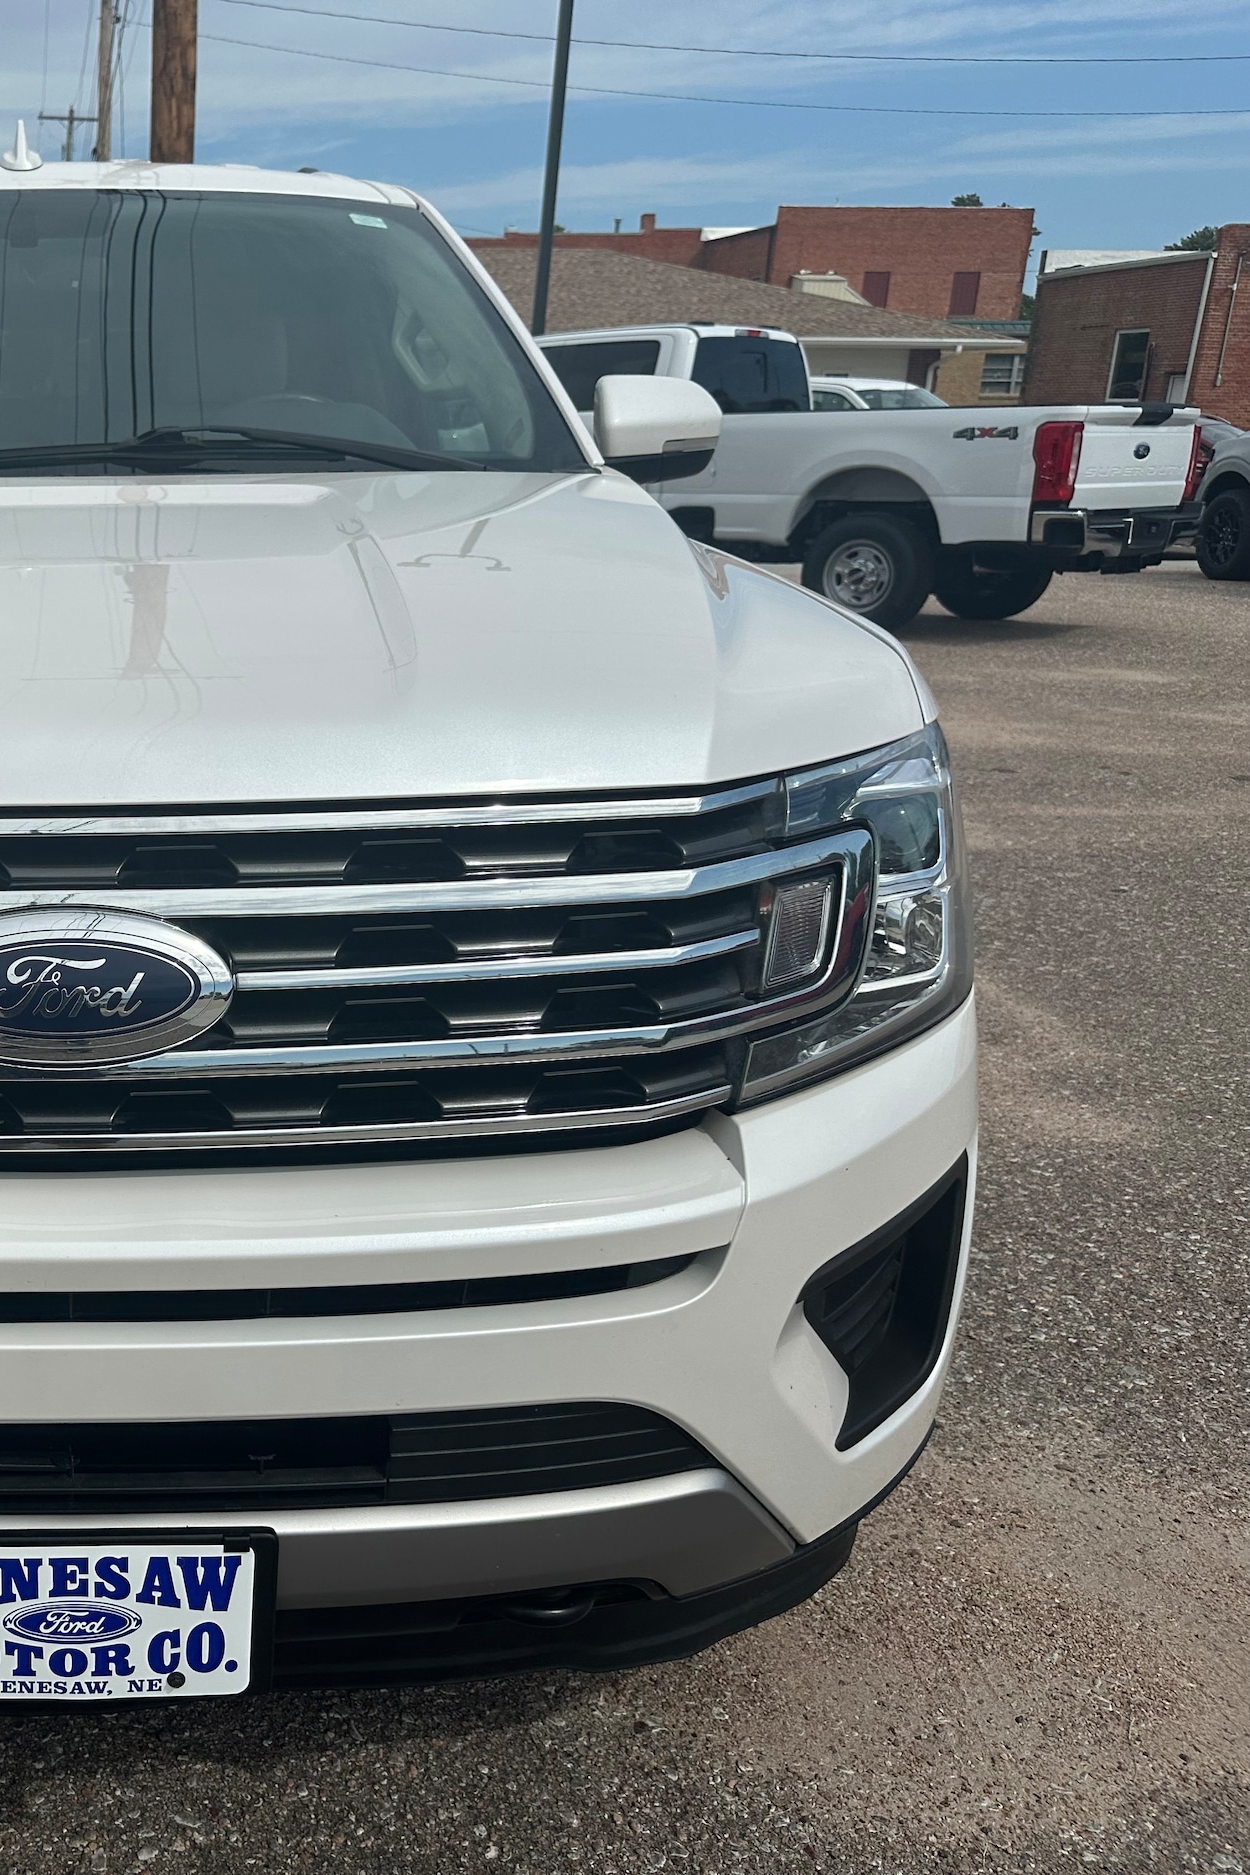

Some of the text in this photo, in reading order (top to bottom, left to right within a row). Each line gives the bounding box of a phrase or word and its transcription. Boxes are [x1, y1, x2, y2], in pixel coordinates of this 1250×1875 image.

[1084, 465, 1184, 478] SUPER DUTY
[39, 1611, 106, 1635] Ford
[147, 1621, 239, 1675] CO.
[127, 1678, 163, 1693] NE
